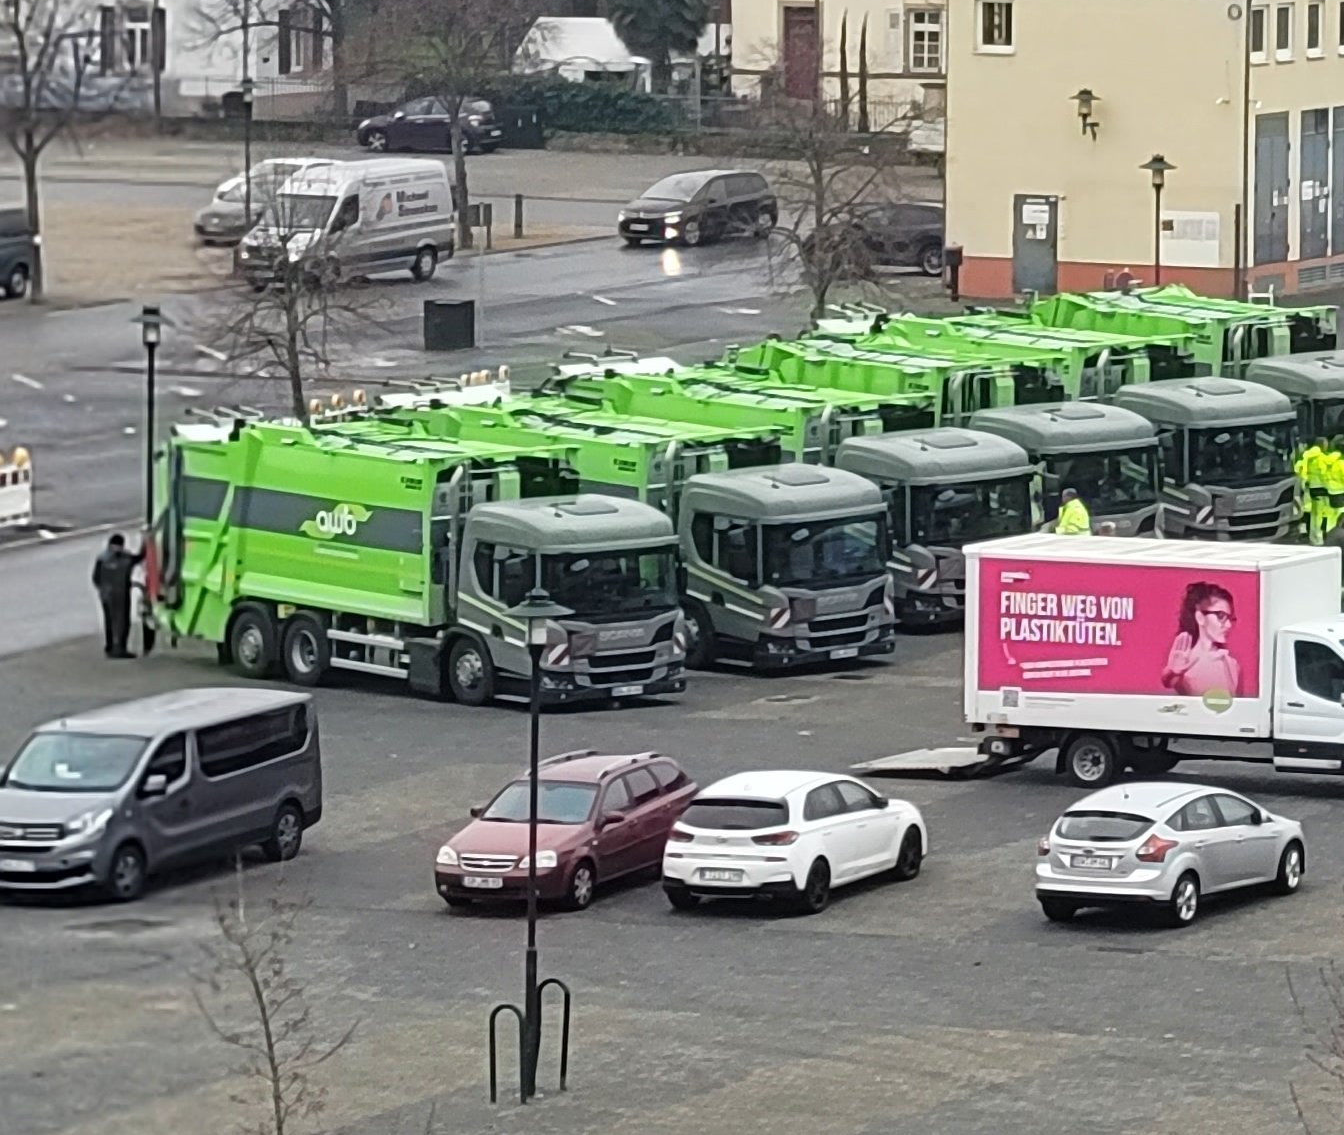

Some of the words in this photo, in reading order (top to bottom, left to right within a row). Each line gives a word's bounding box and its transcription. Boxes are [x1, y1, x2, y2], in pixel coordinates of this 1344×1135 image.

[315, 504, 357, 536] awb
[1000, 591, 1058, 616] FINGER
[1061, 594, 1098, 619] WEG
[1100, 596, 1134, 620] VON
[1000, 616, 1122, 646] PLASTIKTÜTEN.
